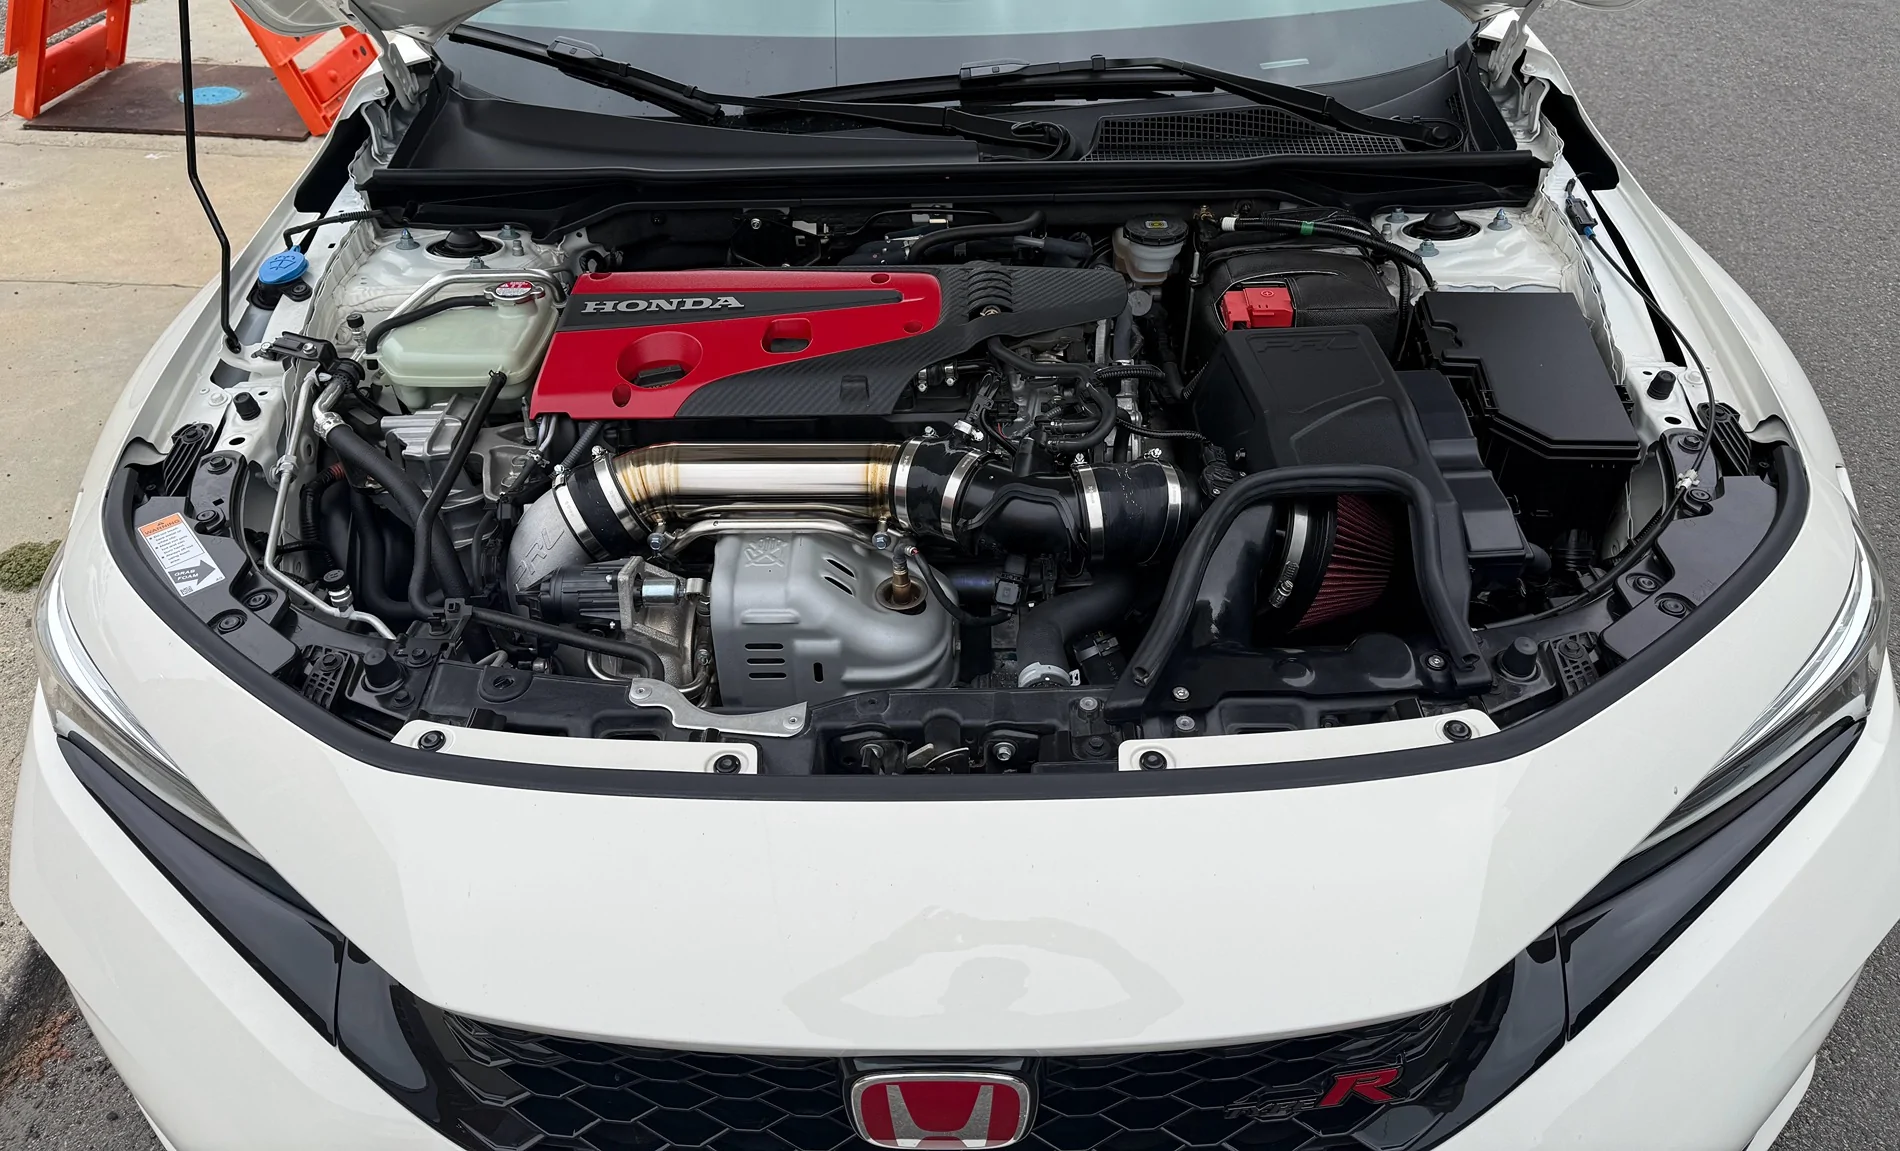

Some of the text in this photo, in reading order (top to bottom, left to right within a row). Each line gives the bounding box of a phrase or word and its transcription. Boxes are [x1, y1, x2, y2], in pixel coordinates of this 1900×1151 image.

[580, 296, 745, 315] HONDA
[144, 519, 181, 535] WARNING
[512, 527, 566, 592] PRL
[173, 569, 197, 577] GRAB
[176, 573, 199, 581] FOAM
[1318, 1066, 1402, 1108] R
